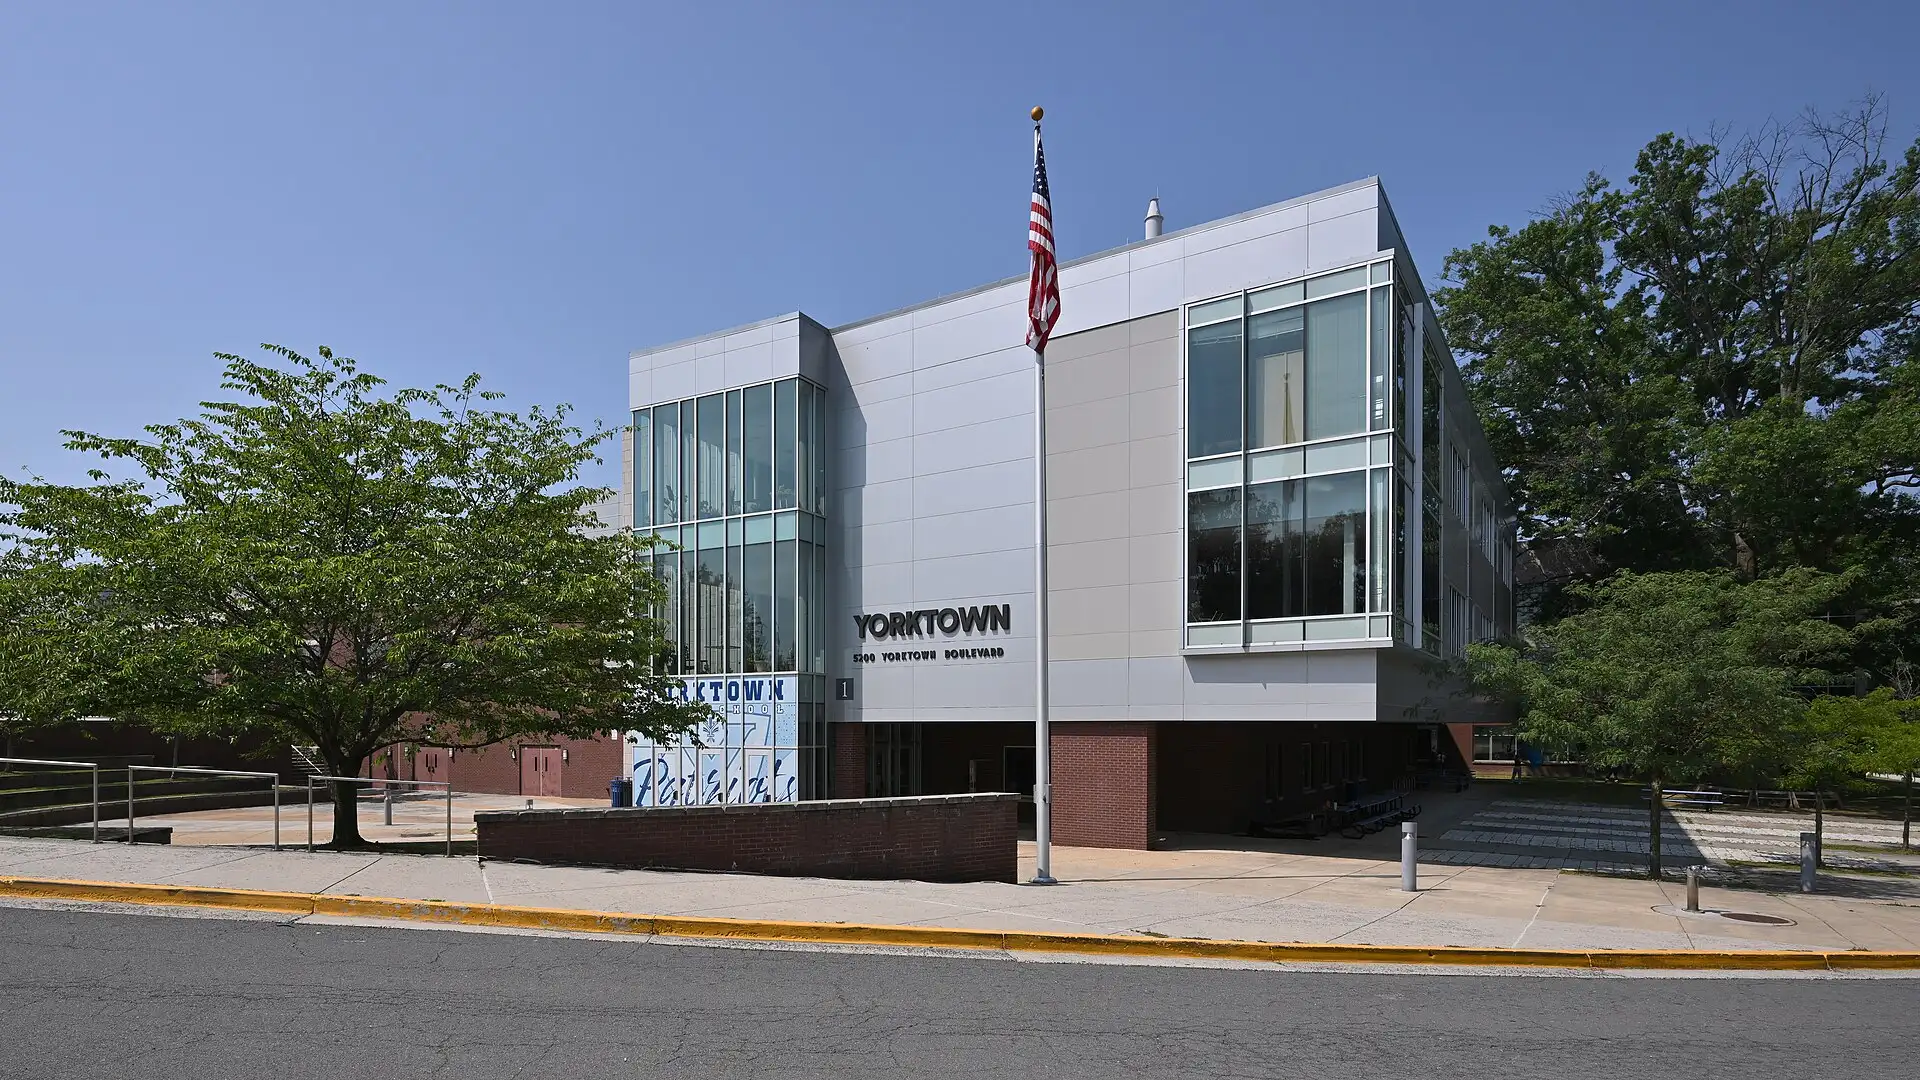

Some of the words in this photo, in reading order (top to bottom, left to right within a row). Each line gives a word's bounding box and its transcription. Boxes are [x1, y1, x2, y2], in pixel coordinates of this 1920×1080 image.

[853, 603, 1011, 639] YORKTOWN
[853, 653, 876, 663] 5200
[881, 650, 937, 662] YORKTOWN
[944, 647, 1005, 660] BOULEVARD
[648, 679, 784, 702] RKTOWN
[841, 681, 848, 698] 1
[705, 704, 785, 714] CHOOL
